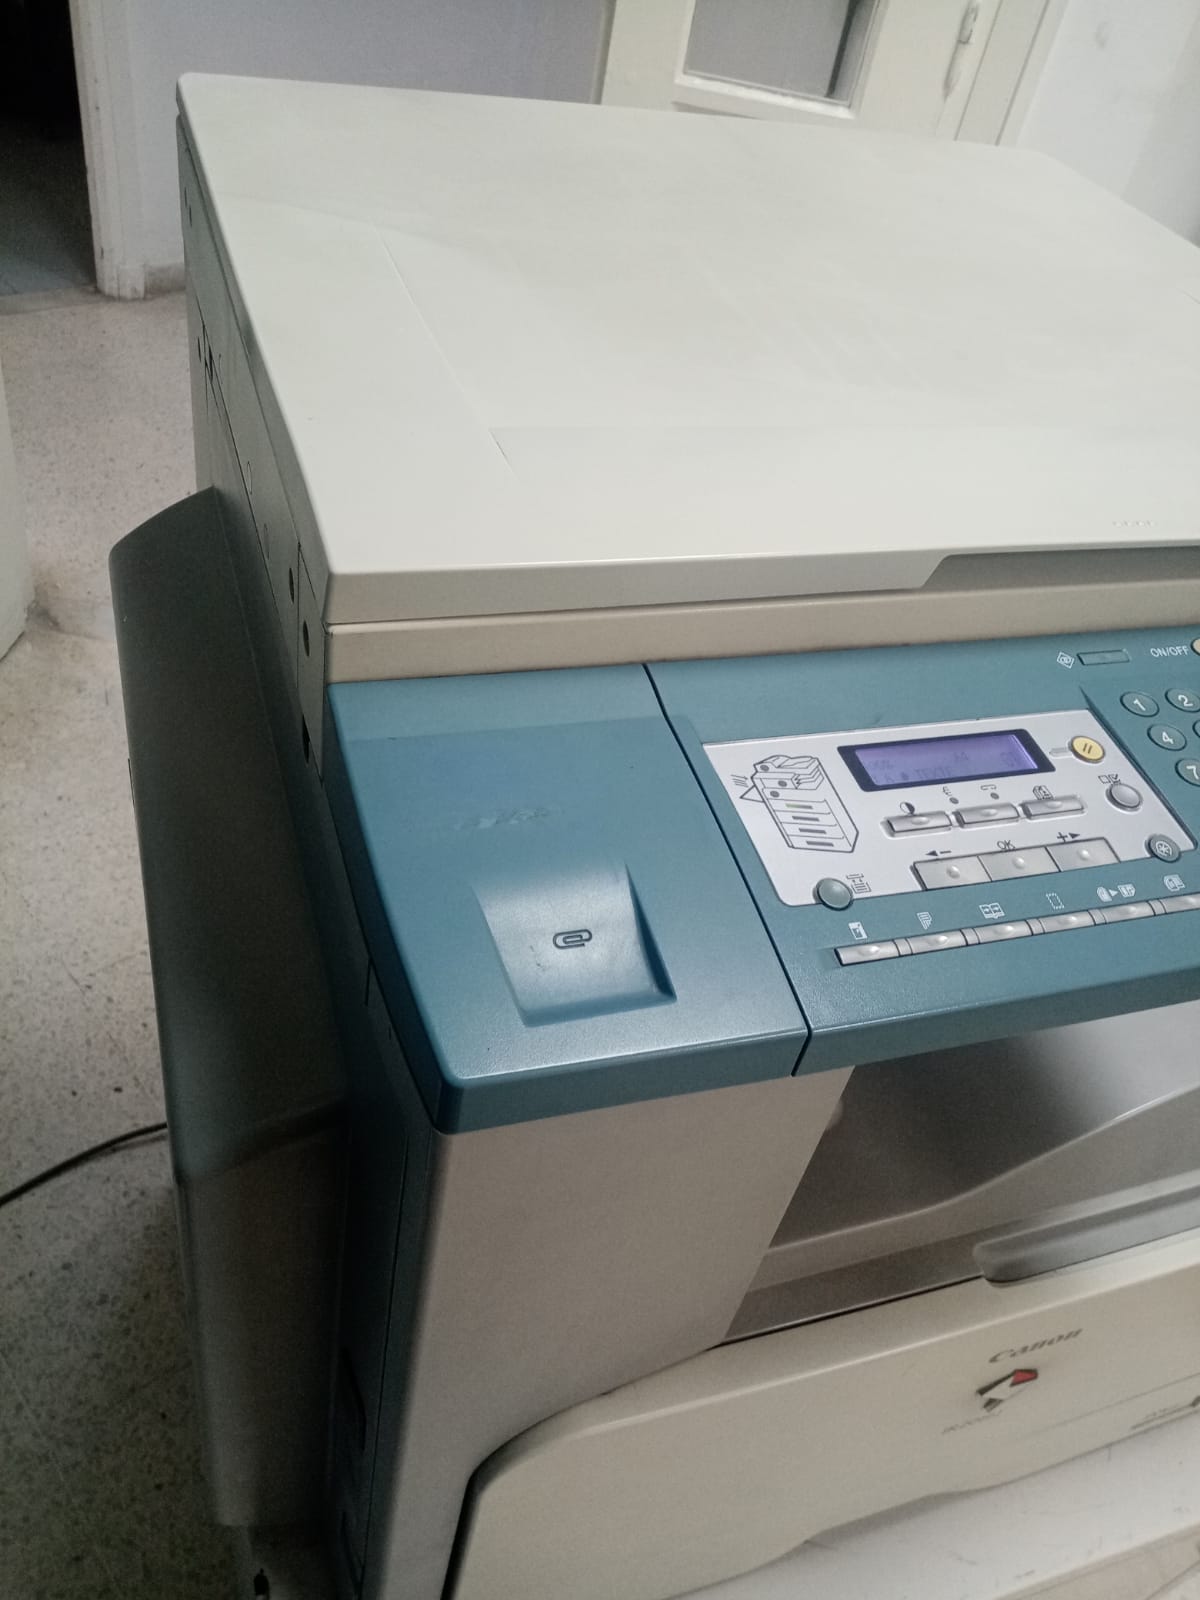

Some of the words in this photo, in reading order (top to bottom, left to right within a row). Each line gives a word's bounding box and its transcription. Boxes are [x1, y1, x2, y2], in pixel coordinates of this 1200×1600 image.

[1150, 645, 1189, 658] ON/OFF
[1133, 698, 1146, 711] 1
[1177, 694, 1193, 707] 2
[1161, 731, 1174, 745] 4
[1186, 765, 1200, 779] 7
[997, 839, 1016, 851] OK
[988, 1328, 1083, 1363] Canon
